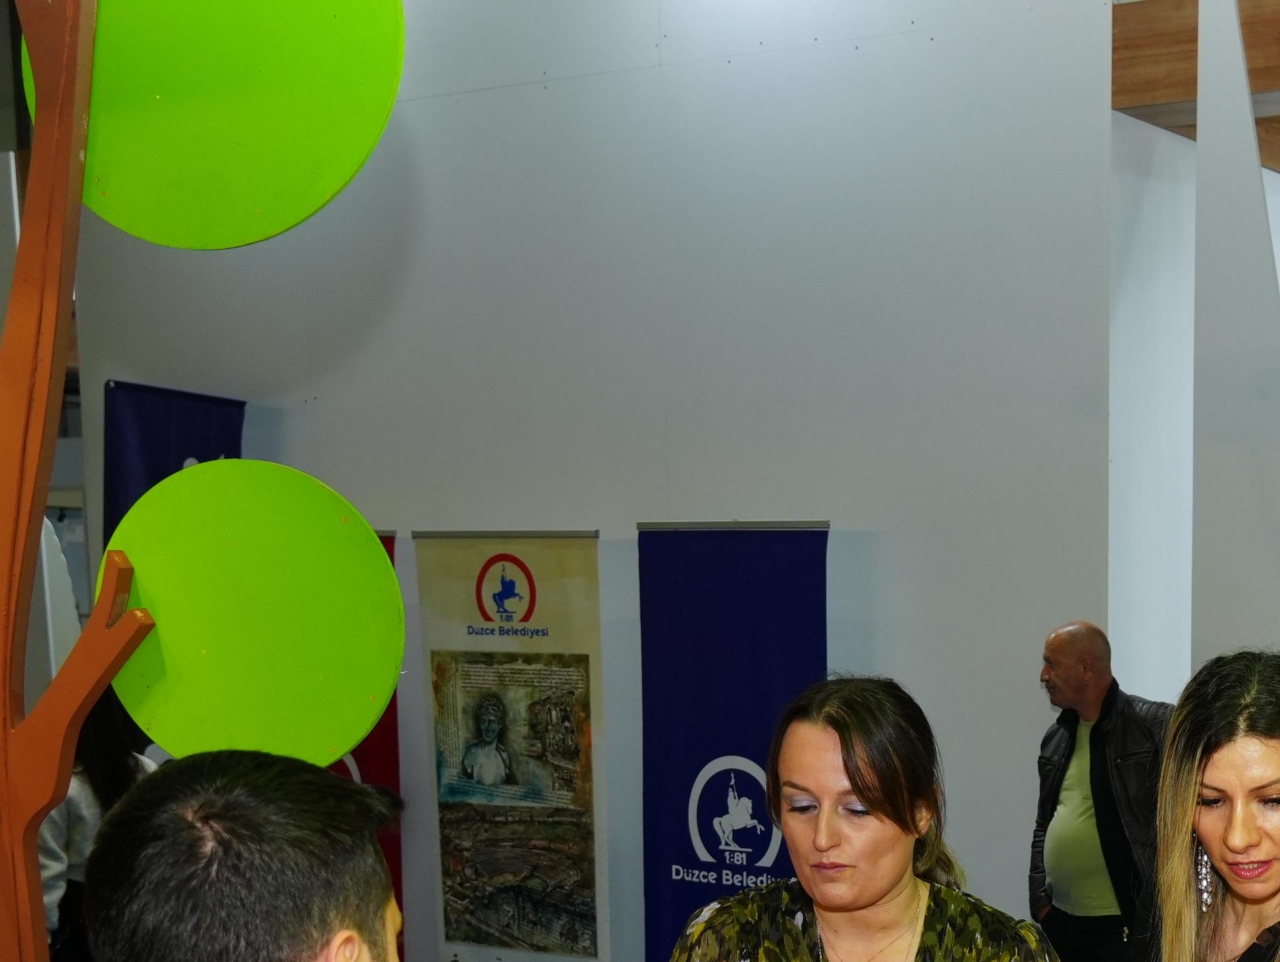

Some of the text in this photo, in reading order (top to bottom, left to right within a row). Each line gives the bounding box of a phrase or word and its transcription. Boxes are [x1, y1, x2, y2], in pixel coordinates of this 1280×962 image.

[499, 626, 549, 639] Belediyesi
[671, 864, 781, 887] Düzce Beledi
